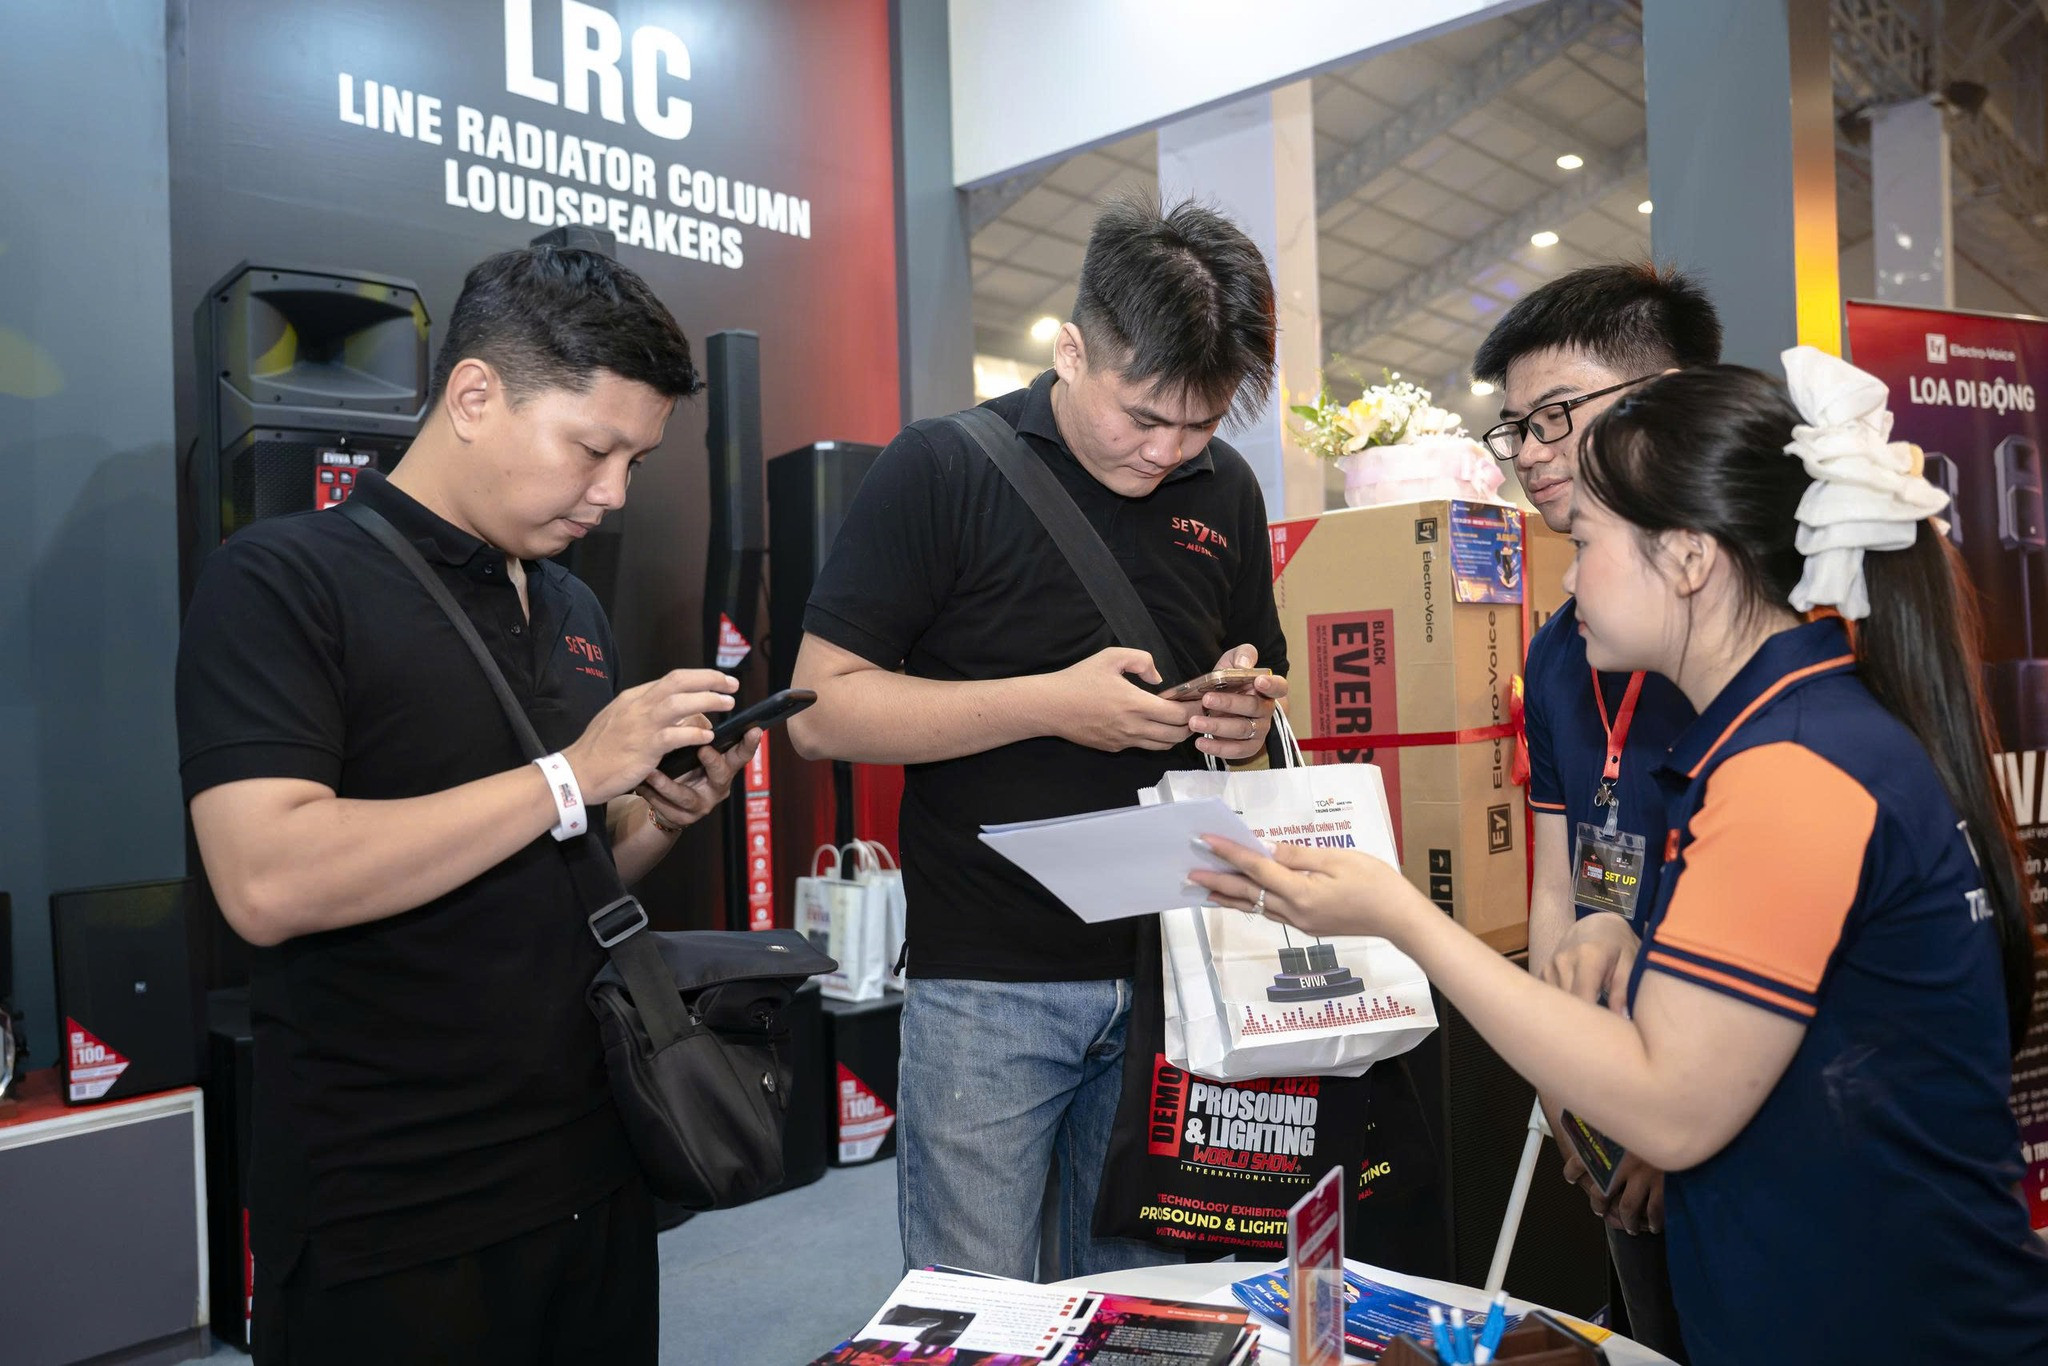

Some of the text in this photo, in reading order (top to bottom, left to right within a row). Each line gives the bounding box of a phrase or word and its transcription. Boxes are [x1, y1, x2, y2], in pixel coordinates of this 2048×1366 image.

[504, 0, 693, 140] LRC
[338, 73, 811, 239] LINE RADIATOR COLUMN
[445, 159, 744, 269] LOUDSPEAKERS
[1949, 343, 2016, 362] Electro-Voice
[1909, 375, 2036, 416] LOA DI ĐỘNG
[1423, 551, 1434, 643] Electro-Voice
[1373, 621, 1386, 666] BLACK
[1332, 622, 1375, 765] EVERS
[1605, 870, 1621, 883] SET
[1622, 875, 1637, 886] UP
[1300, 975, 1328, 988] EVIVA
[78, 1045, 106, 1065] 100
[849, 1095, 876, 1118] 100
[1152, 1066, 1183, 1144] DEMO
[1189, 1082, 1319, 1126] PROSOUND
[1184, 1116, 1316, 1157] & LIGHTING
[1180, 1164, 1311, 1185] INTERNATIONAL LEVEL
[1193, 1145, 1298, 1173] WORLD SHOW
[1207, 1235, 1284, 1249] INTERNATIONAL
[1225, 1218, 1236, 1231] &
[1240, 1220, 1288, 1235] LIGHTI
